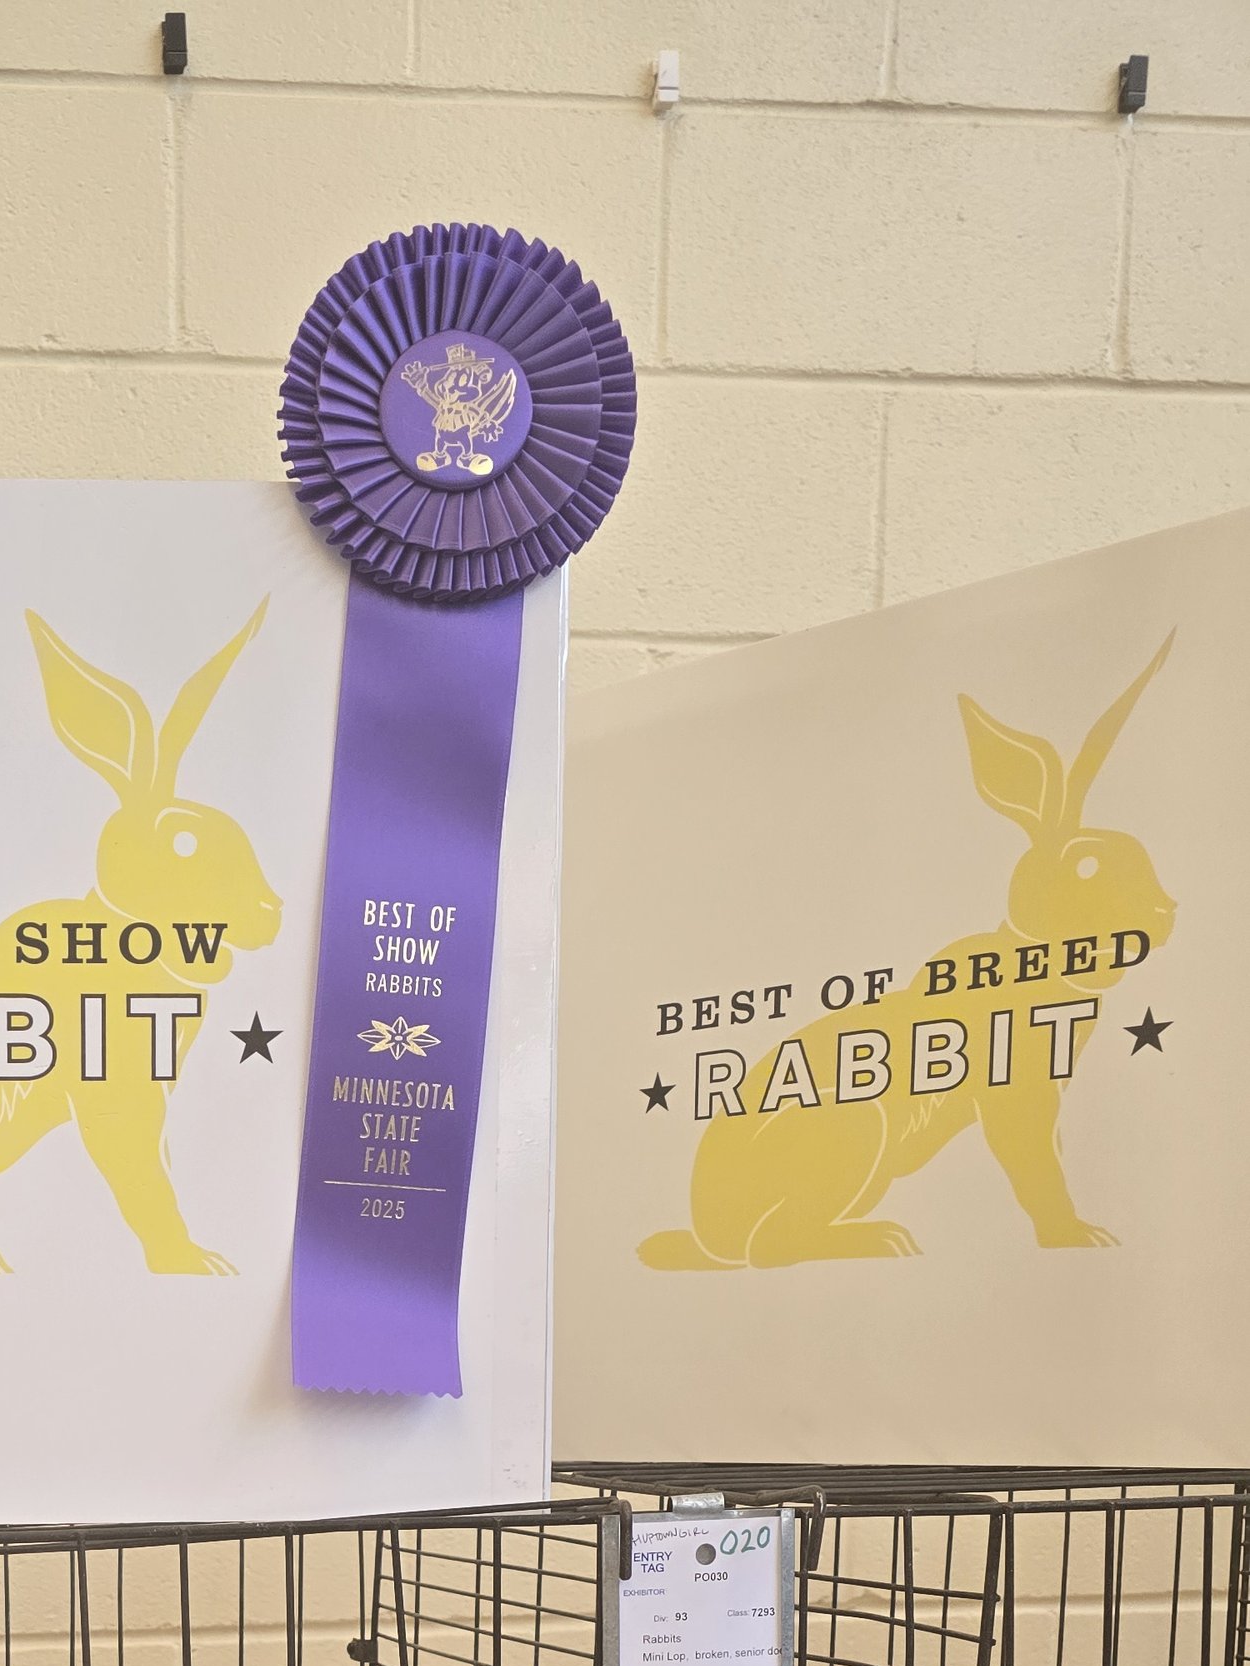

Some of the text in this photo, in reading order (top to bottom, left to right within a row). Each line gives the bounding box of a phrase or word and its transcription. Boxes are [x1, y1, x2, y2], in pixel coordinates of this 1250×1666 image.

[363, 900, 456, 932] BEST OF
[15, 922, 228, 965] SHOW
[373, 935, 439, 966] SHOW
[366, 973, 443, 997] RABBITS
[656, 929, 1150, 1036] BEST OF BREED
[694, 997, 1099, 1121] RABBIT
[333, 1076, 455, 1111] MINNESOTA
[360, 1113, 421, 1142] STATE
[363, 1147, 411, 1176] FAIR
[360, 1198, 405, 1220] 2025
[634, 1551, 673, 1562] ENTRY
[641, 1563, 664, 1573] TAG
[623, 1589, 665, 1597] EXHIBITOR
[675, 1612, 688, 1621] 93
[751, 1607, 775, 1617] 7293
[642, 1634, 682, 1644] Rabbits
[642, 1652, 664, 1662] Mini
[695, 1649, 732, 1660] broken,
[735, 1647, 764, 1658] senior
